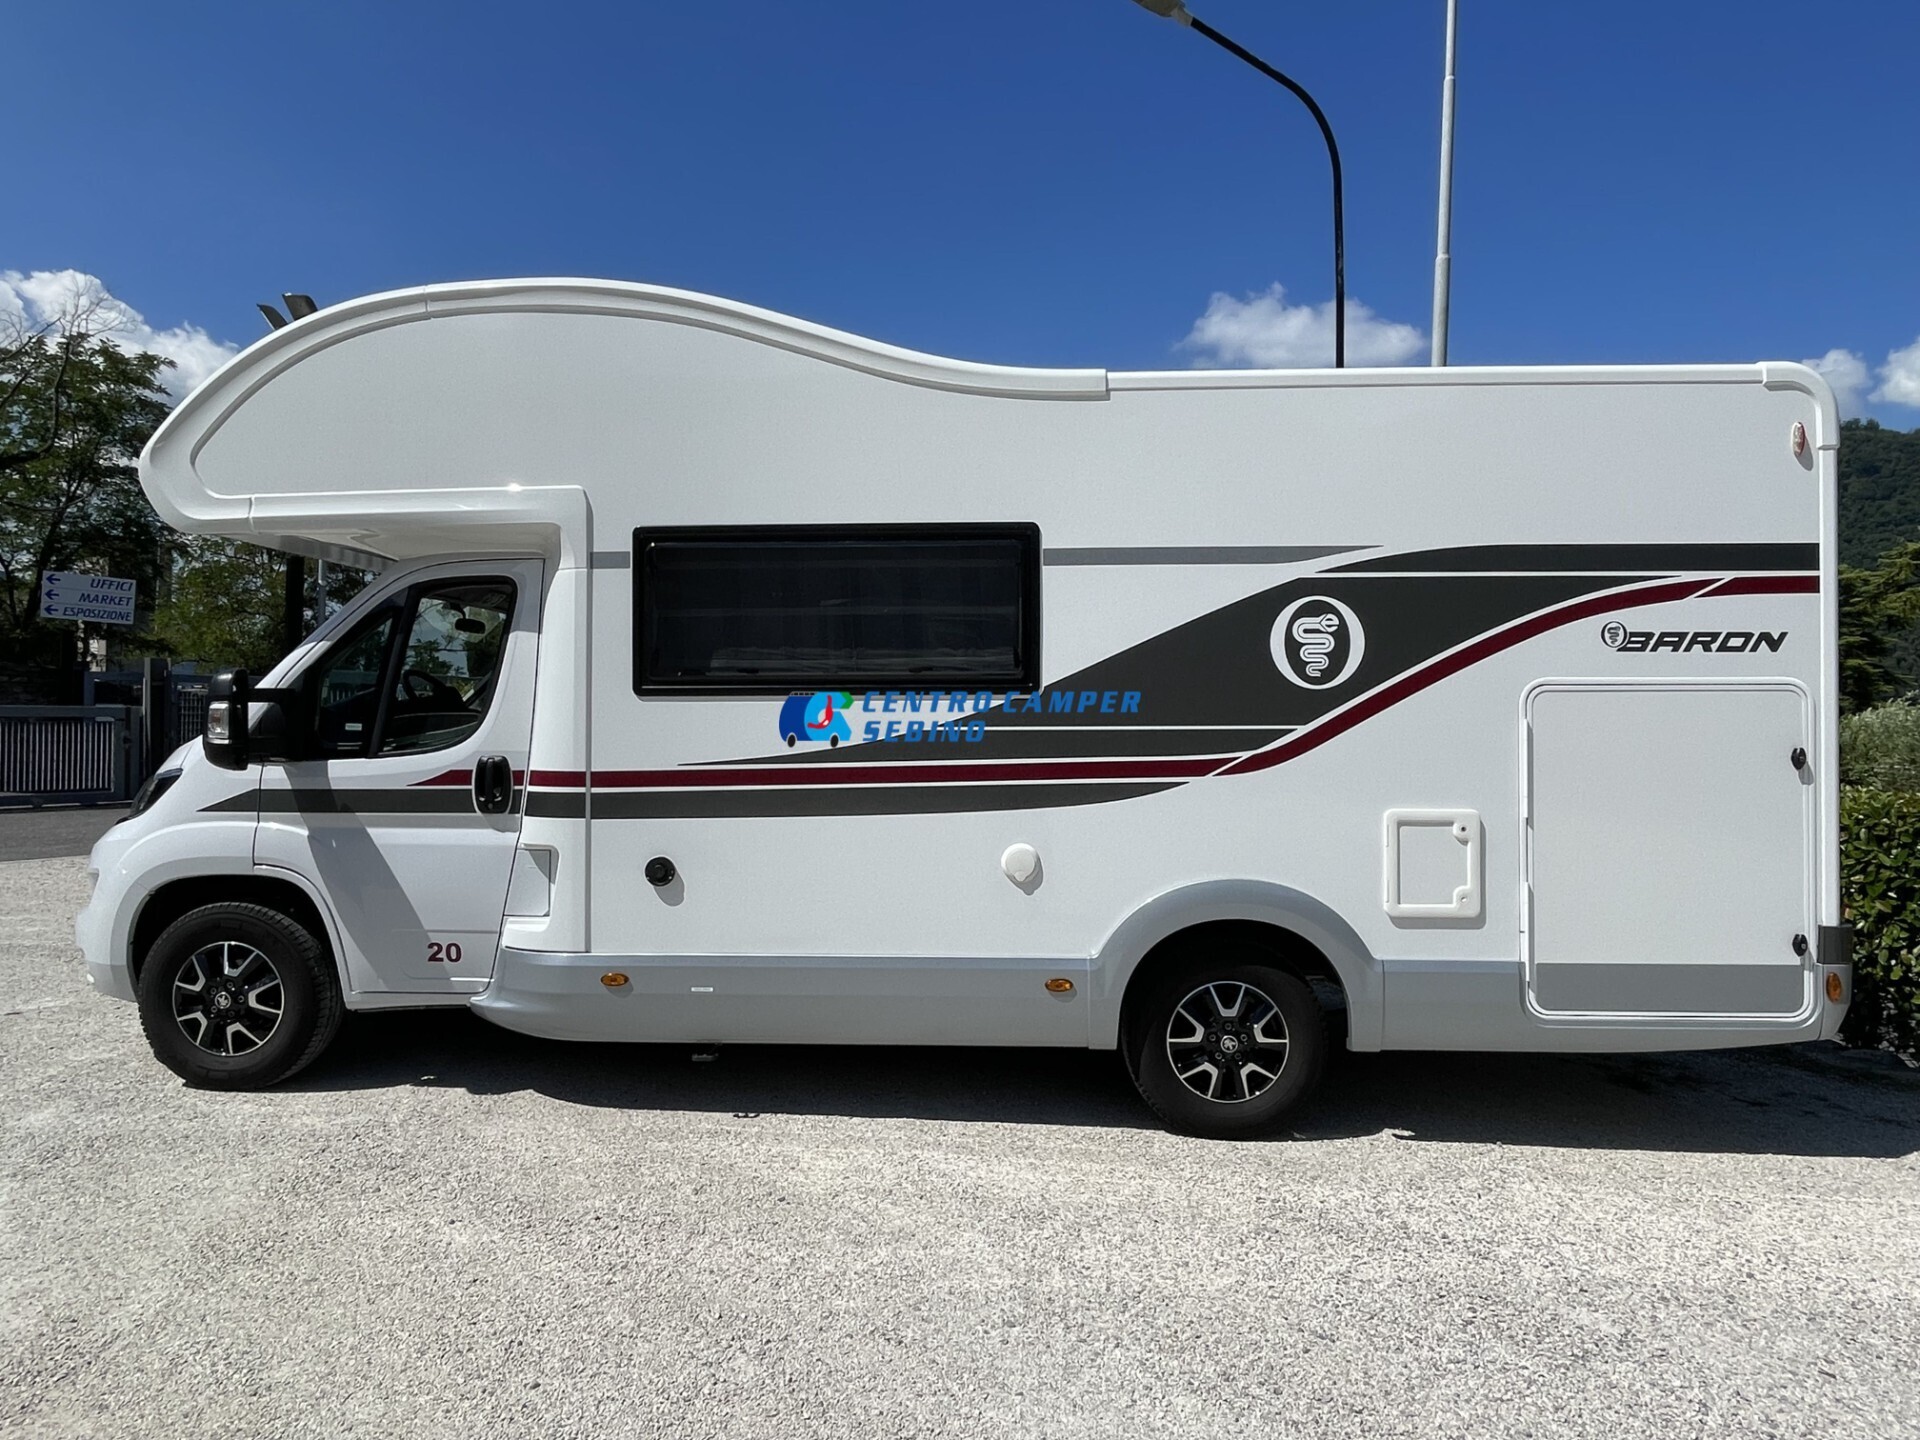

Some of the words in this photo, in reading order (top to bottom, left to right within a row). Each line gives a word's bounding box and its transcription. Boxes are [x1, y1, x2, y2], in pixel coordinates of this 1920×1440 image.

[90, 579, 133, 592] UFFICI
[79, 593, 133, 606] MARKET
[63, 606, 132, 621] ESPOSIZIONE
[1616, 631, 1789, 653] BARON
[427, 942, 462, 963] 20
